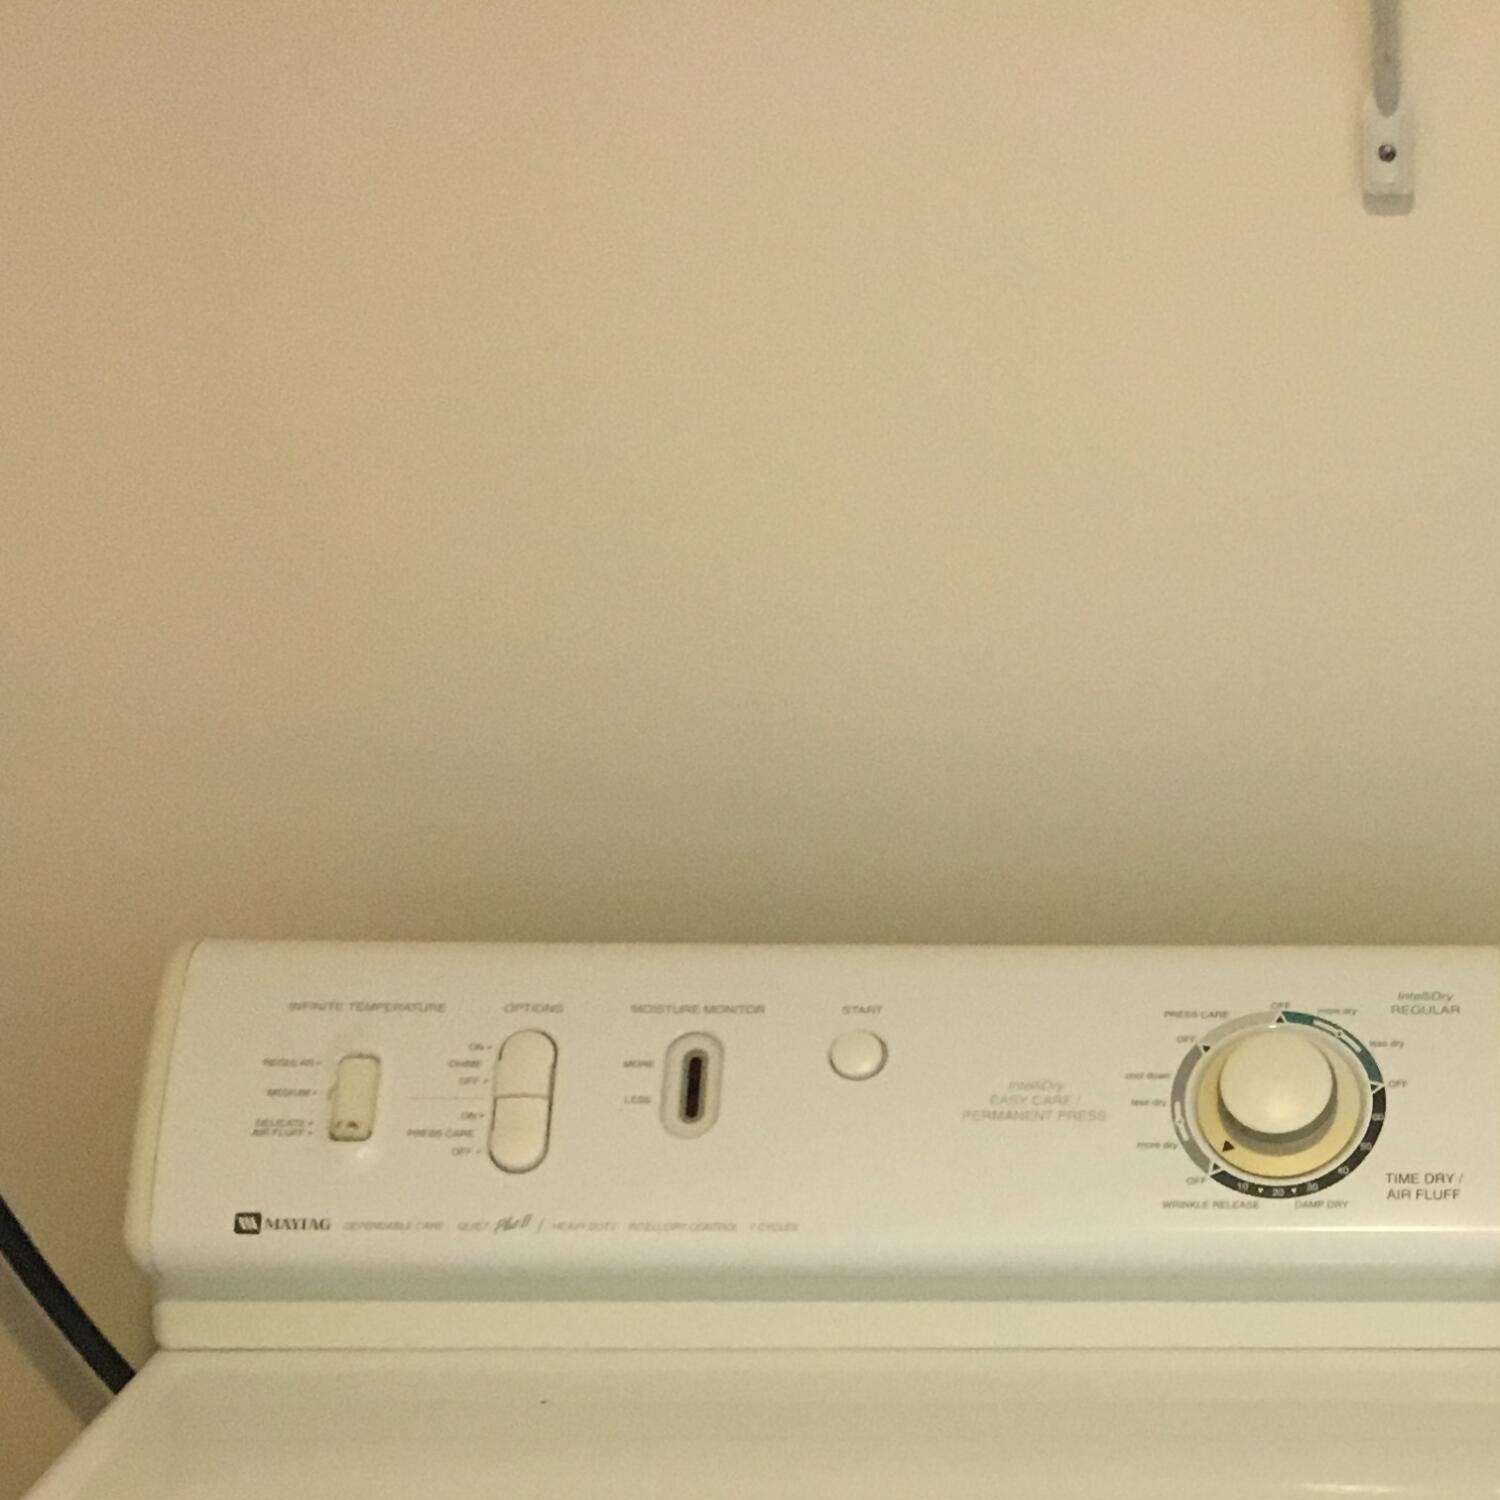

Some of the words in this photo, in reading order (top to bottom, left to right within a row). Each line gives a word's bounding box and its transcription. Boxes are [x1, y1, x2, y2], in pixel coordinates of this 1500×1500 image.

[288, 1001, 344, 1013] INFINITE
[349, 1001, 446, 1014] TEMPERATURE
[503, 1003, 564, 1014] OPTIONS
[630, 1004, 699, 1015] MOISTURE
[703, 1004, 766, 1015] MONITOR
[841, 1005, 883, 1015] START
[1270, 1002, 1291, 1010] OFF
[1390, 1004, 1461, 1015] REGULAR
[1200, 1010, 1229, 1019] CARE
[1387, 1079, 1408, 1089] OFF
[624, 1095, 651, 1104] LESS
[989, 1094, 1028, 1106] EASY
[1031, 1094, 1072, 1106] CARE
[961, 1109, 1054, 1122] PERMANENT
[1057, 1109, 1107, 1122] PRESS
[1185, 1176, 1206, 1186] OFF
[1386, 1172, 1419, 1184] TIME
[1424, 1172, 1455, 1184] DRY
[1387, 1189, 1413, 1200] AIR
[1416, 1189, 1461, 1200] FLUFF
[1162, 1201, 1209, 1210] WRINKLE
[1212, 1201, 1259, 1210] RELEASE
[1294, 1201, 1324, 1210] DAMP
[1327, 1201, 1349, 1210] DRY
[264, 1217, 332, 1231] MAYTAG
